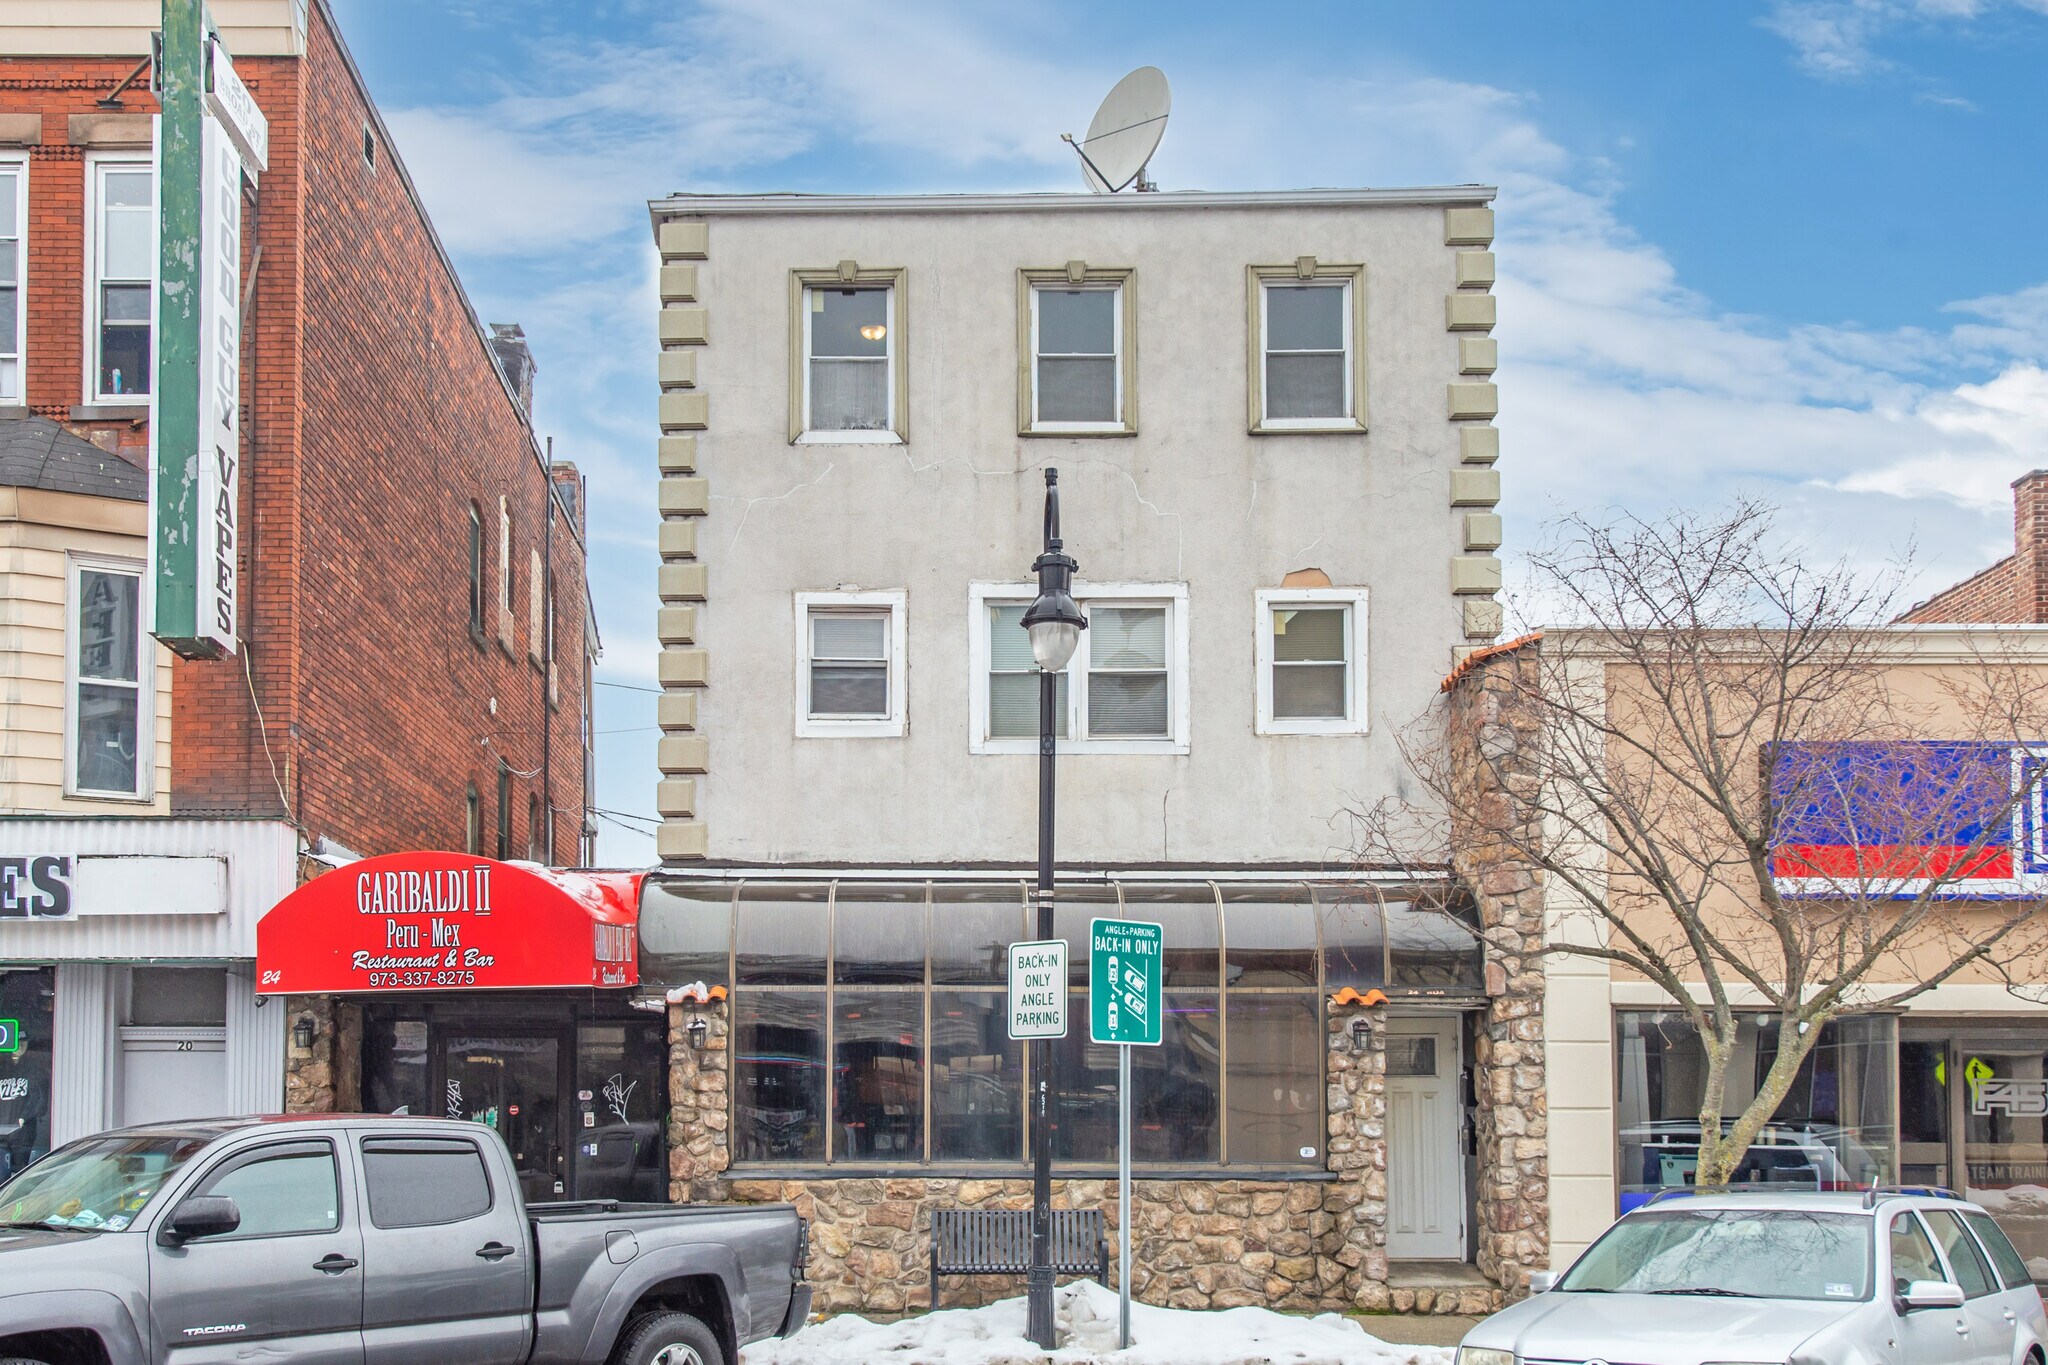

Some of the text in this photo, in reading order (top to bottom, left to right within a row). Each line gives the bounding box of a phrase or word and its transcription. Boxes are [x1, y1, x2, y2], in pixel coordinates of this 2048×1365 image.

[220, 74, 248, 126] BROAD
[231, 77, 252, 114] 20
[215, 147, 236, 636] GOOD GUY VAPES
[357, 864, 491, 916] GARIBALDI II
[386, 918, 419, 949] Peru
[431, 917, 461, 948] Mex
[1105, 925, 1155, 937] ANGLE PARKING
[1094, 936, 1159, 955] BACK-IN ONLY
[352, 948, 495, 971] Restaurant & Bar
[1018, 954, 1058, 969] BACK-IN
[261, 970, 281, 985] 24
[369, 970, 475, 987] 973-337-8275
[1025, 973, 1051, 987] ONLY
[1111, 970, 1116, 979] 2
[1021, 992, 1054, 1007] ANGLE
[1016, 1011, 1059, 1026] PARKING
[177, 1040, 193, 1051] 20
[1975, 1081, 2048, 1114] F45
[1971, 1166, 2004, 1178] TEAM
[182, 1323, 246, 1336] TACOMA
